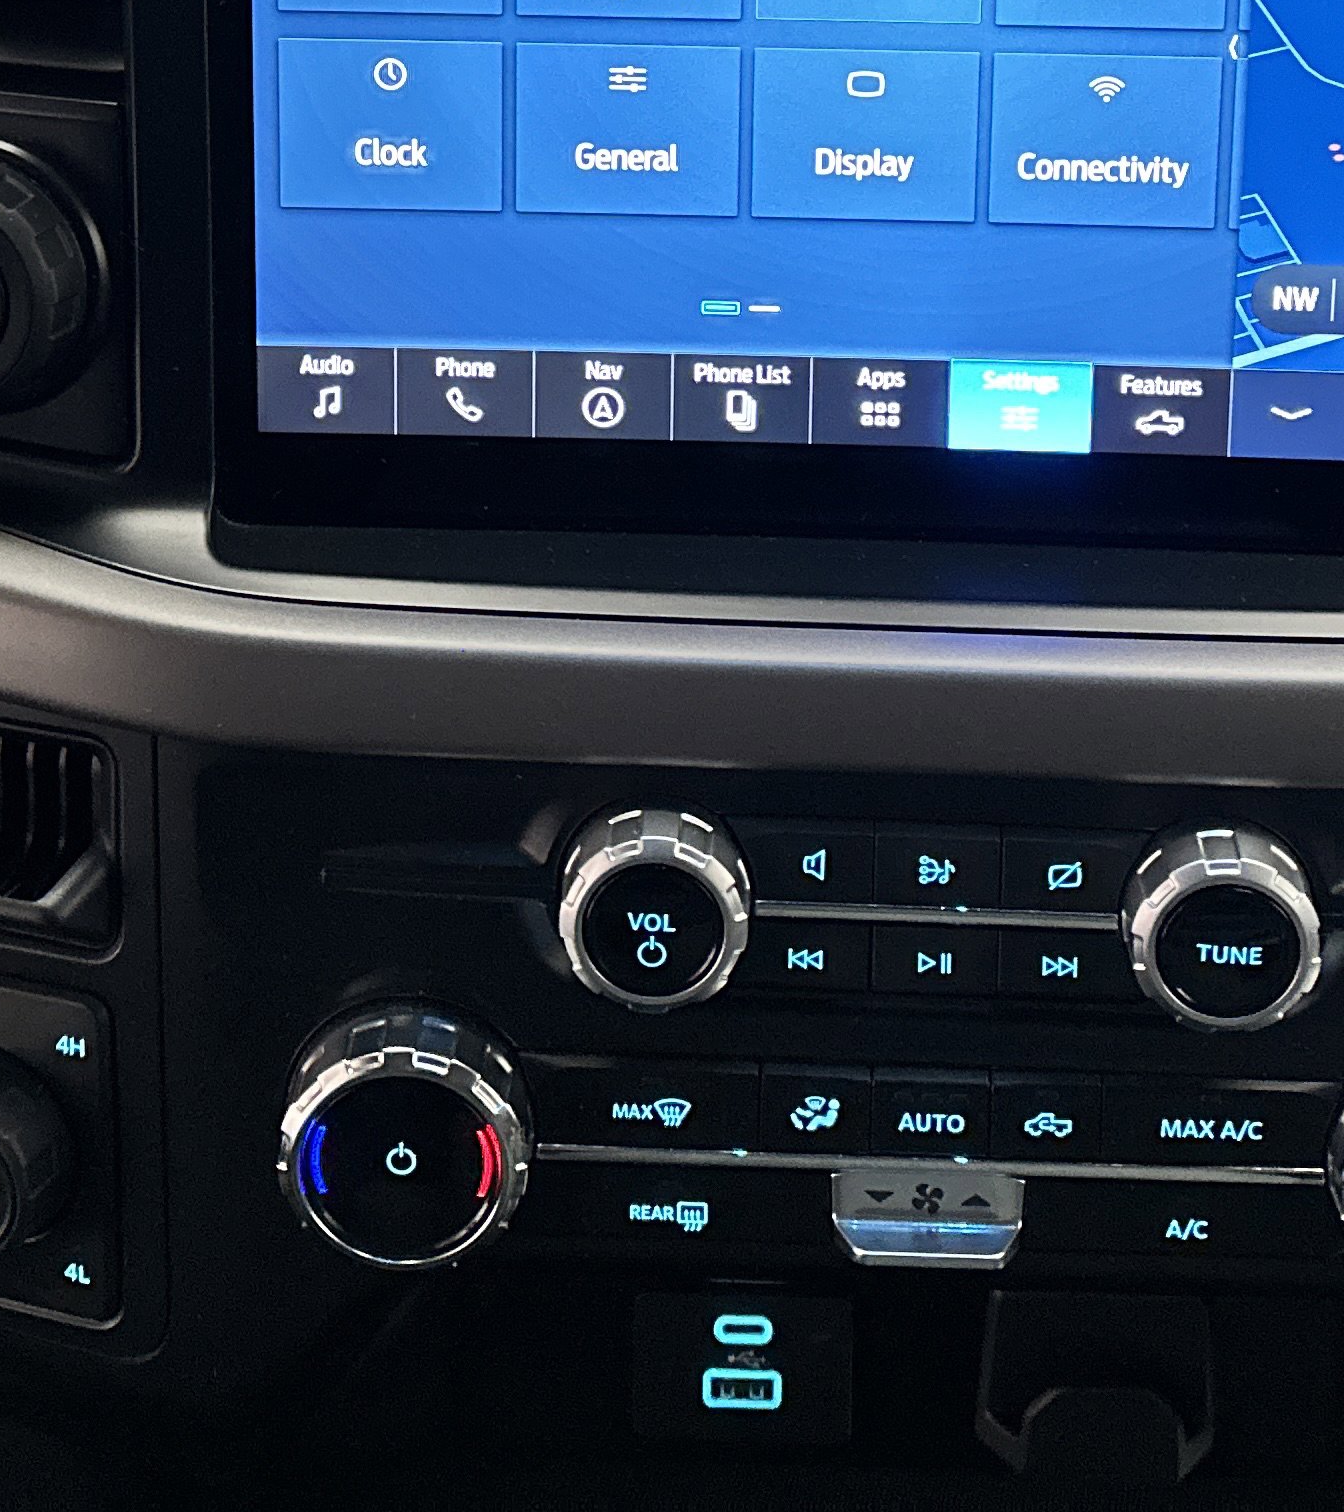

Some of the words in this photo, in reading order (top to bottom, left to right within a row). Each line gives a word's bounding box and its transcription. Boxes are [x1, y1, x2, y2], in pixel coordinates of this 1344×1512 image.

[354, 137, 428, 168] Clock
[574, 144, 679, 173] General
[814, 148, 914, 182] Display
[1017, 152, 1190, 190] Connectivity
[1272, 286, 1319, 312] NW
[299, 354, 354, 377] Audio
[434, 356, 496, 381] Phone
[585, 360, 623, 382] Nav
[693, 362, 754, 385] Phone
[755, 363, 791, 386] List
[857, 367, 906, 392] Apps
[982, 369, 1060, 396] Settings
[1120, 373, 1204, 397] Features
[627, 911, 676, 934] VOL
[1196, 943, 1264, 966] TUNE
[55, 1035, 86, 1058] 4H
[612, 1102, 654, 1122] MAX
[897, 1112, 965, 1134] AUTO
[1159, 1118, 1215, 1140] MAX
[1219, 1118, 1264, 1142] A/C
[628, 1203, 675, 1222] REAR
[1165, 1218, 1210, 1242] A/C
[63, 1262, 91, 1285] 4L
